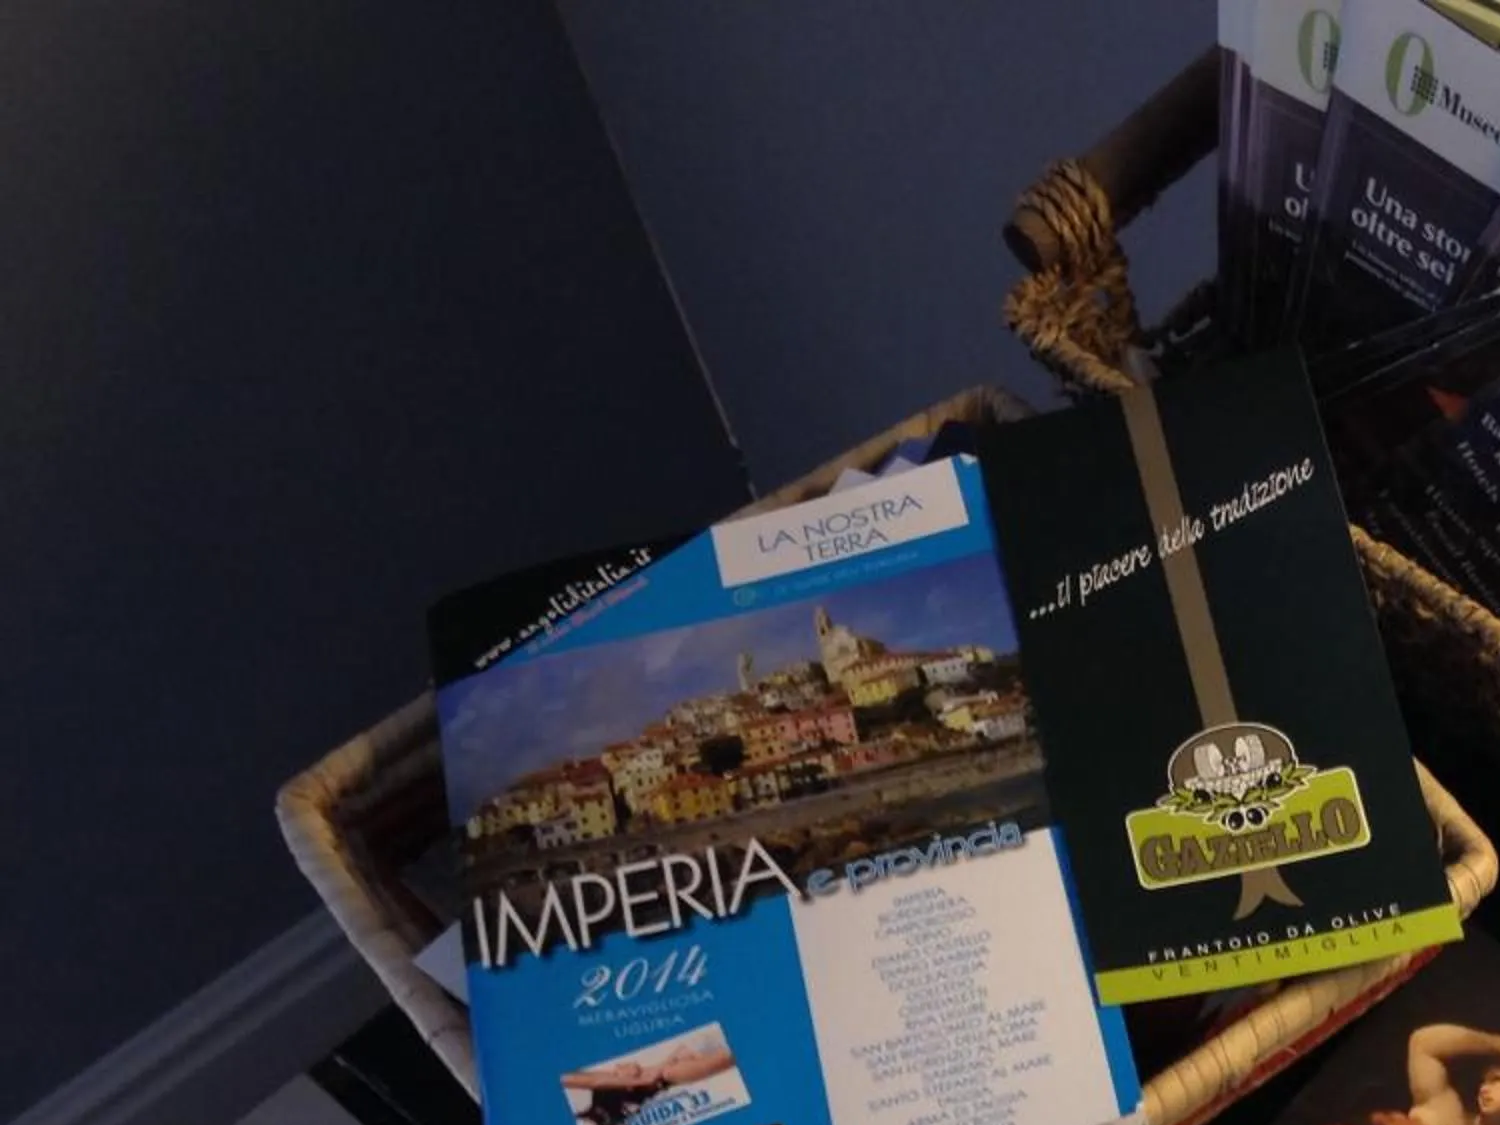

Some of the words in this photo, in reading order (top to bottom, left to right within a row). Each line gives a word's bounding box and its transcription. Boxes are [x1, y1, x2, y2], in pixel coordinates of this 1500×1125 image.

[1351, 208, 1413, 257] oltre
[1366, 177, 1418, 231] Una
[1455, 440, 1498, 505] Hotels
[755, 525, 797, 554] LA
[800, 490, 924, 541] NOSTRA
[802, 525, 888, 562] TERRA
[1079, 544, 1151, 606] piacere
[1157, 514, 1205, 559] della
[1210, 457, 1314, 532] tradizione
[473, 837, 803, 971] IMPERIA
[806, 866, 843, 899] e
[845, 818, 1026, 896] provincia
[1148, 931, 1270, 963] FRANTOIO
[1287, 922, 1316, 940] DA
[1331, 902, 1402, 931] OLIVE
[1151, 921, 1406, 982] VENTIMIGLIA
[574, 944, 710, 1010] 2014
[577, 988, 717, 1029] MERAVIGLIOSA
